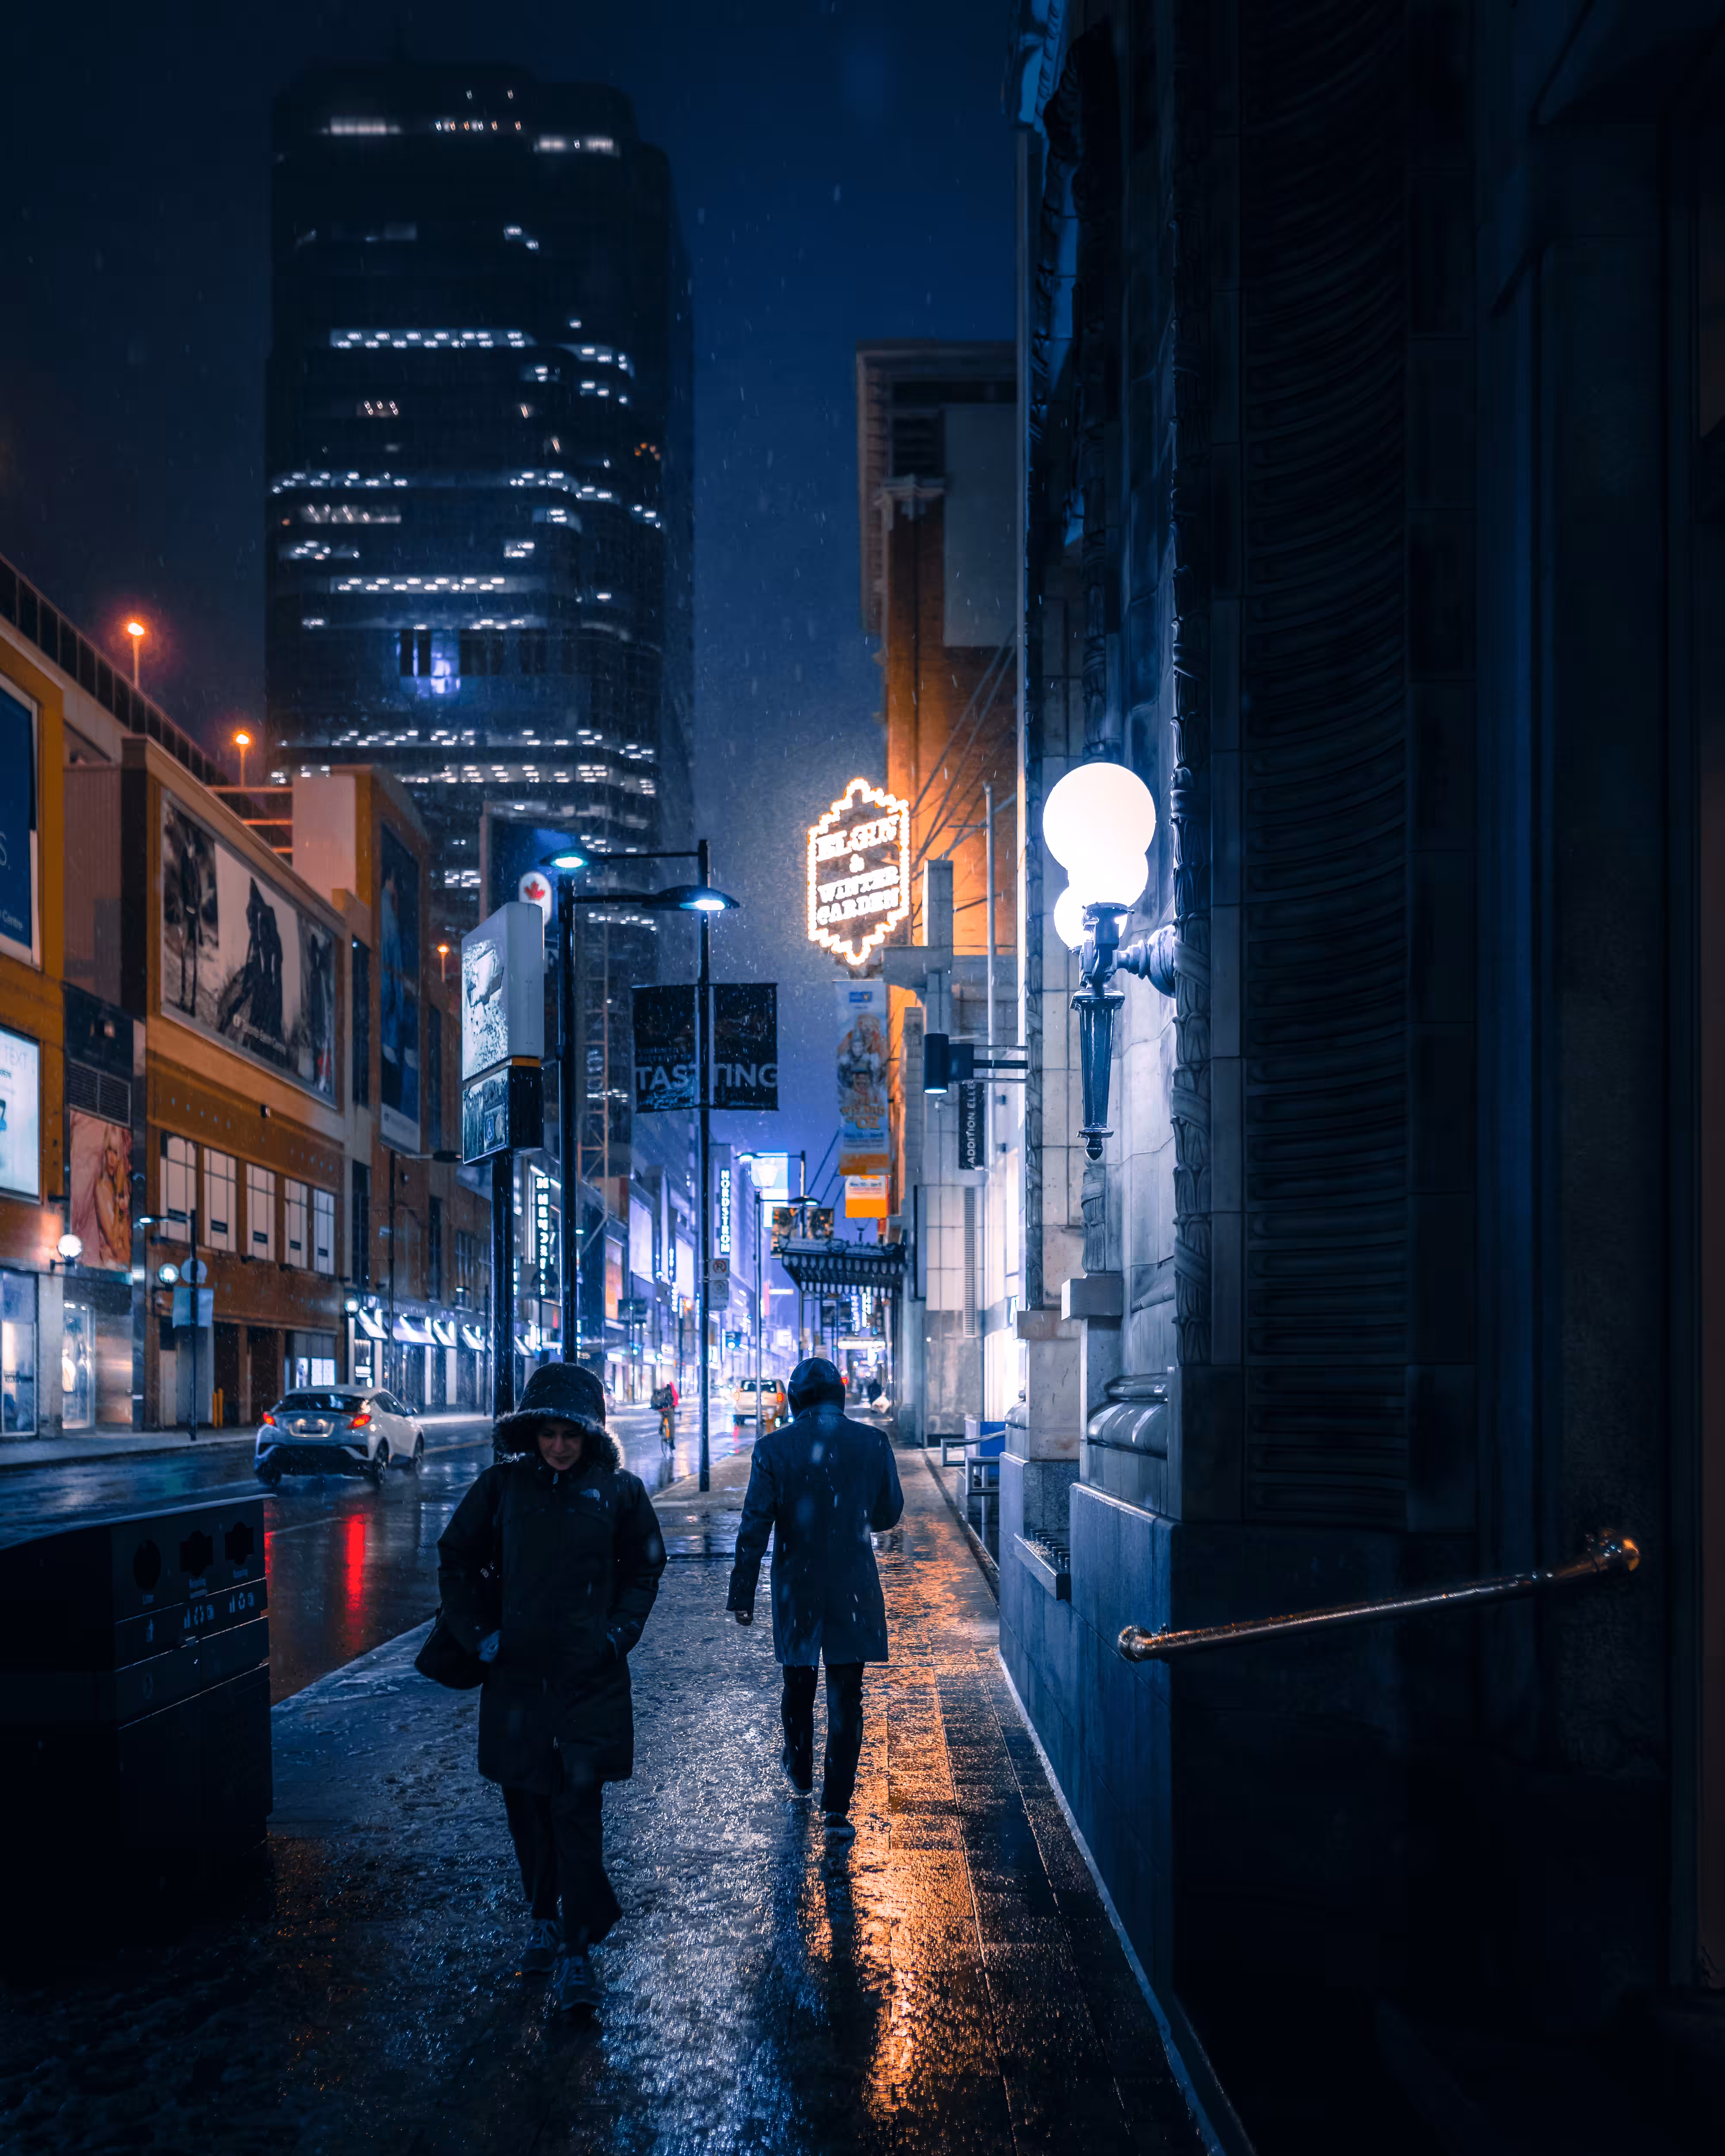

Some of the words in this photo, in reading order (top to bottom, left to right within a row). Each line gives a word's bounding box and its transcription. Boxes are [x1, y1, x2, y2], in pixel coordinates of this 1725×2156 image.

[817, 865, 900, 904] WINTER
[817, 887, 900, 925] GARDEN
[966, 1113, 977, 1164] ADDITION
[720, 1169, 730, 1253] NORDSTROM
